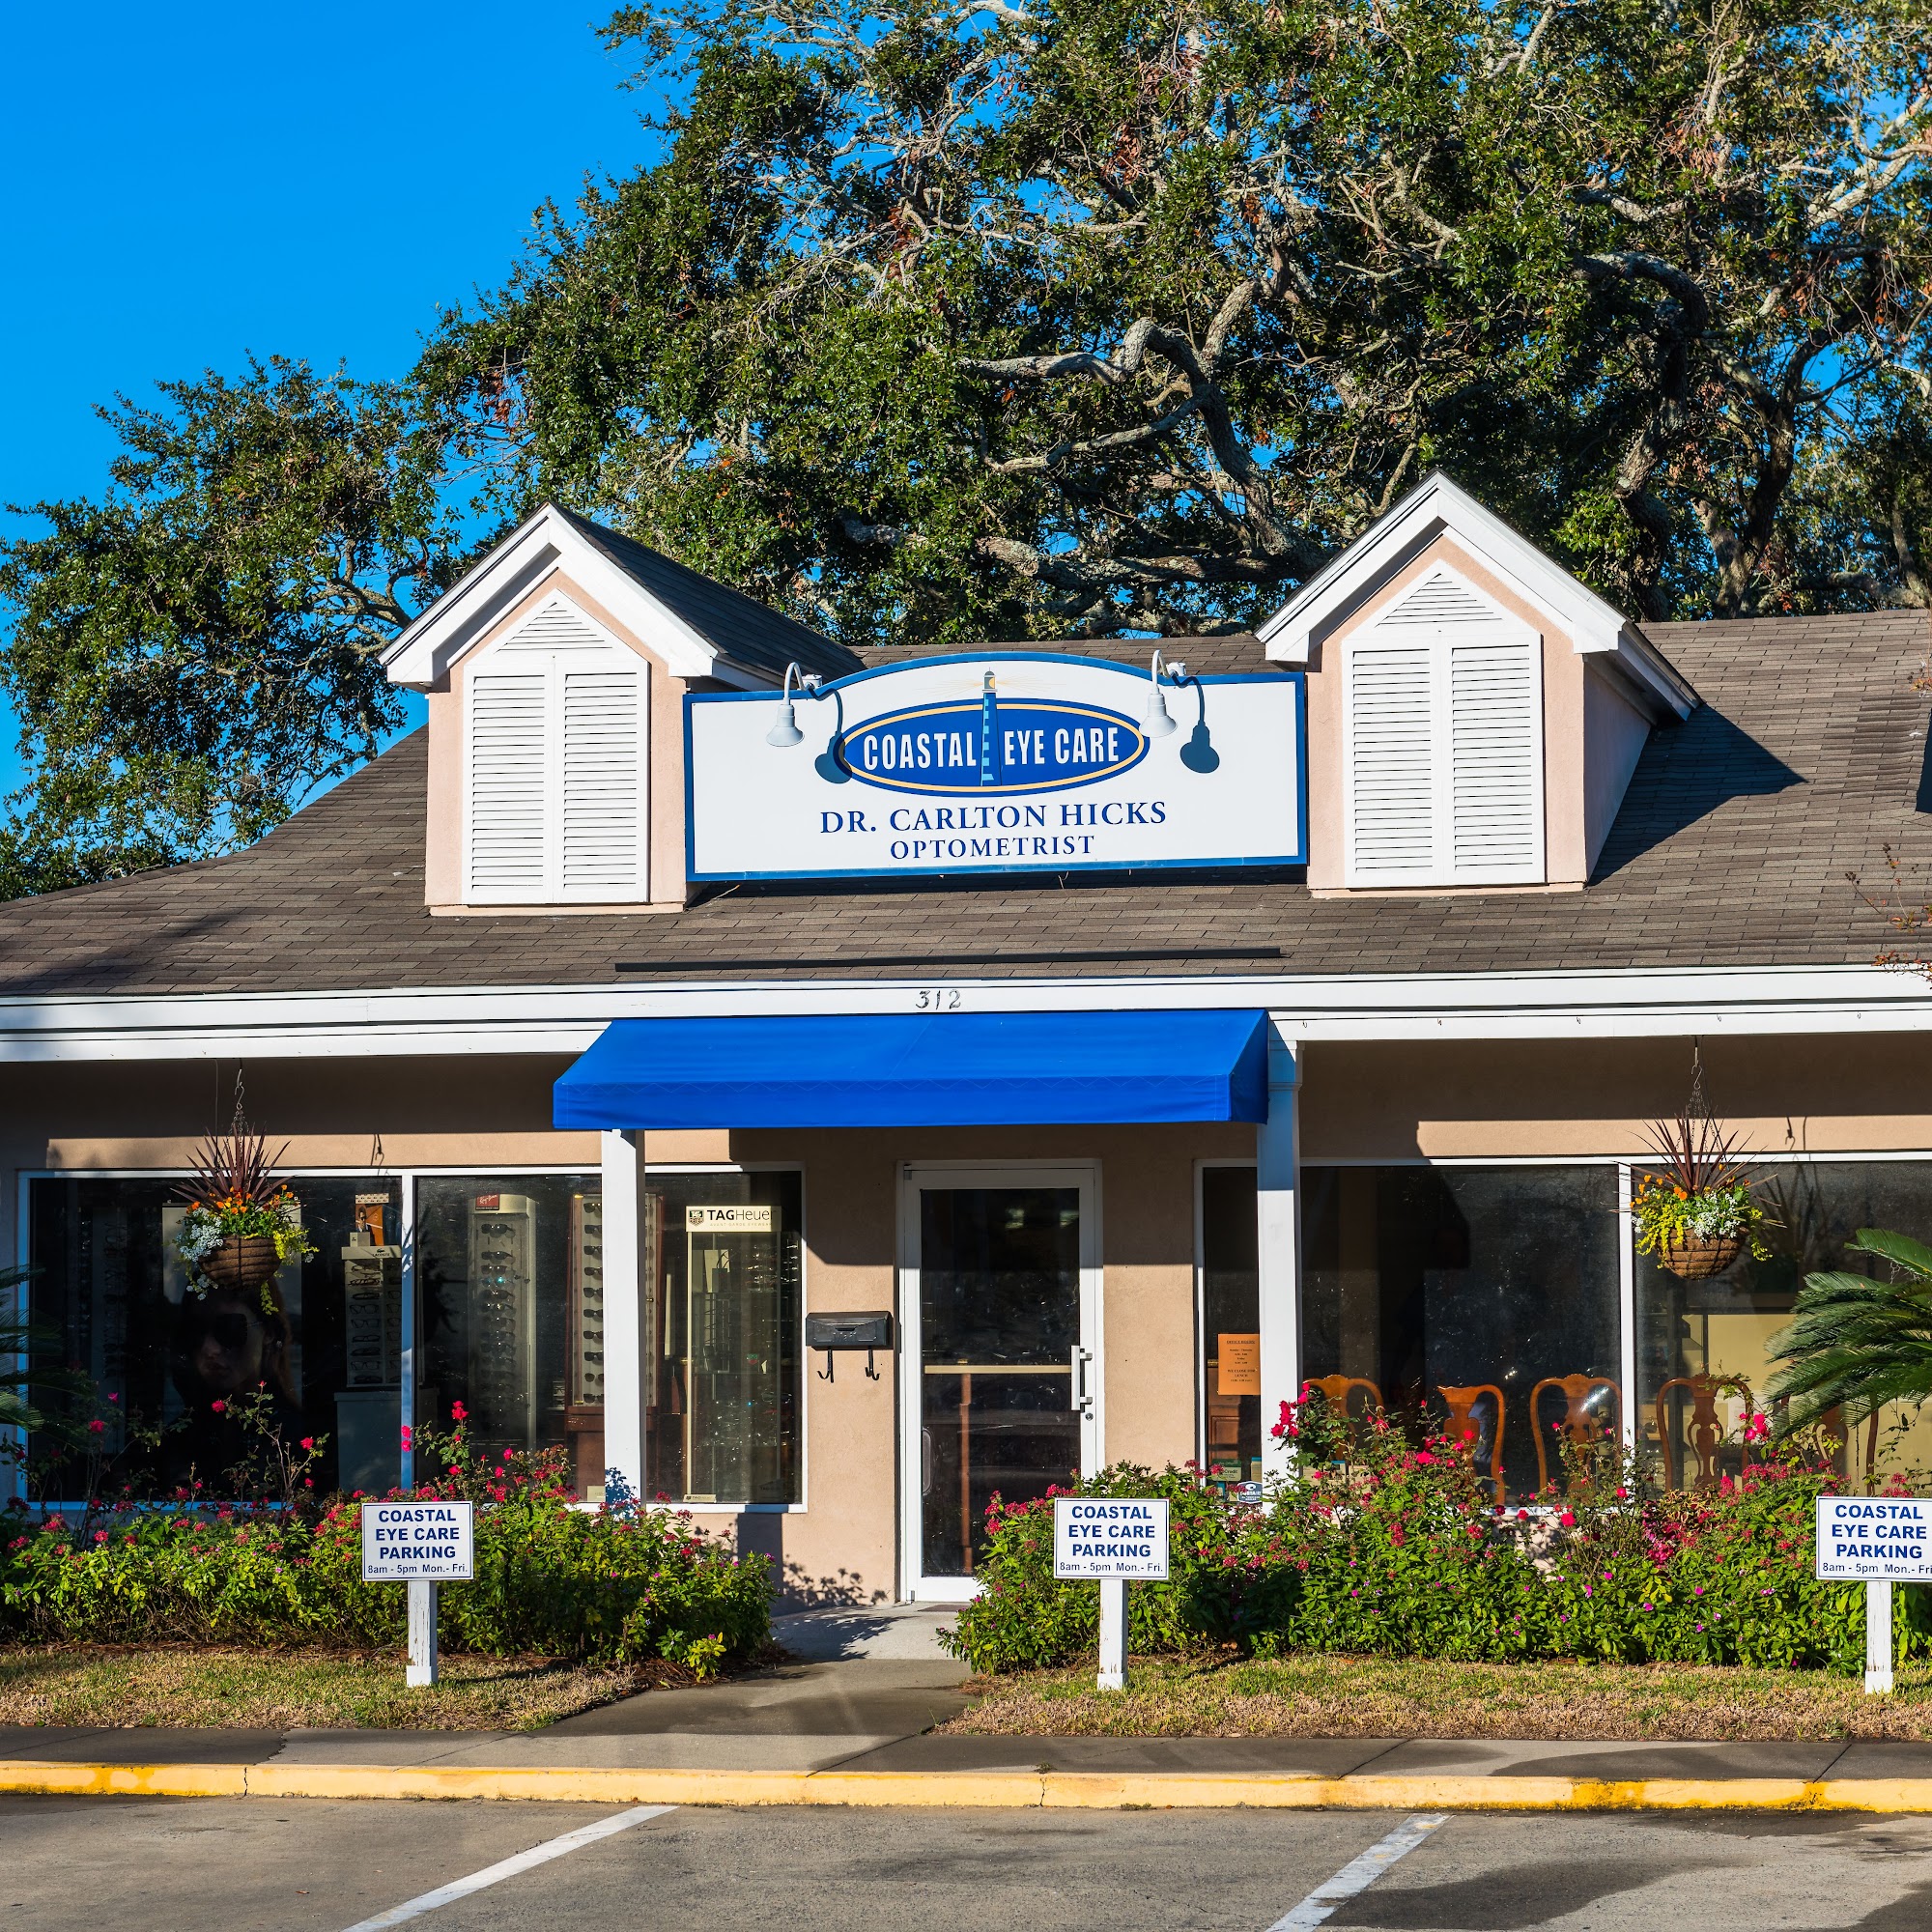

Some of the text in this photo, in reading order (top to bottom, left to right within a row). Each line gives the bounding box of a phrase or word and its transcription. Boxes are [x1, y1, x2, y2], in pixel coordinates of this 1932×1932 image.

[863, 726, 1120, 771] COASTAL EYE CARE
[820, 801, 1167, 834] DR. CARLTON HICKS
[890, 835, 1095, 860] OPTOMETRIST
[915, 989, 961, 1010] 312
[379, 1509, 457, 1523] COASTAL
[1071, 1505, 1152, 1520] COASTAL
[1834, 1504, 1923, 1520] COASTAL
[375, 1527, 460, 1541] EYE CARE
[1068, 1524, 1155, 1539] EYE CARE
[1832, 1523, 1927, 1540] EYE CARE
[380, 1546, 456, 1560] PARKING
[1072, 1544, 1151, 1557] PARKING
[1836, 1544, 1922, 1559] PARKING
[367, 1564, 388, 1574] 8am
[397, 1564, 417, 1575] 5pm
[452, 1563, 469, 1573] Fri.
[1060, 1561, 1080, 1571] 8am
[1090, 1562, 1111, 1573] 5pm
[1147, 1562, 1163, 1572] Fri.
[1822, 1562, 1845, 1572] 8am
[1856, 1563, 1879, 1574] 5pm
